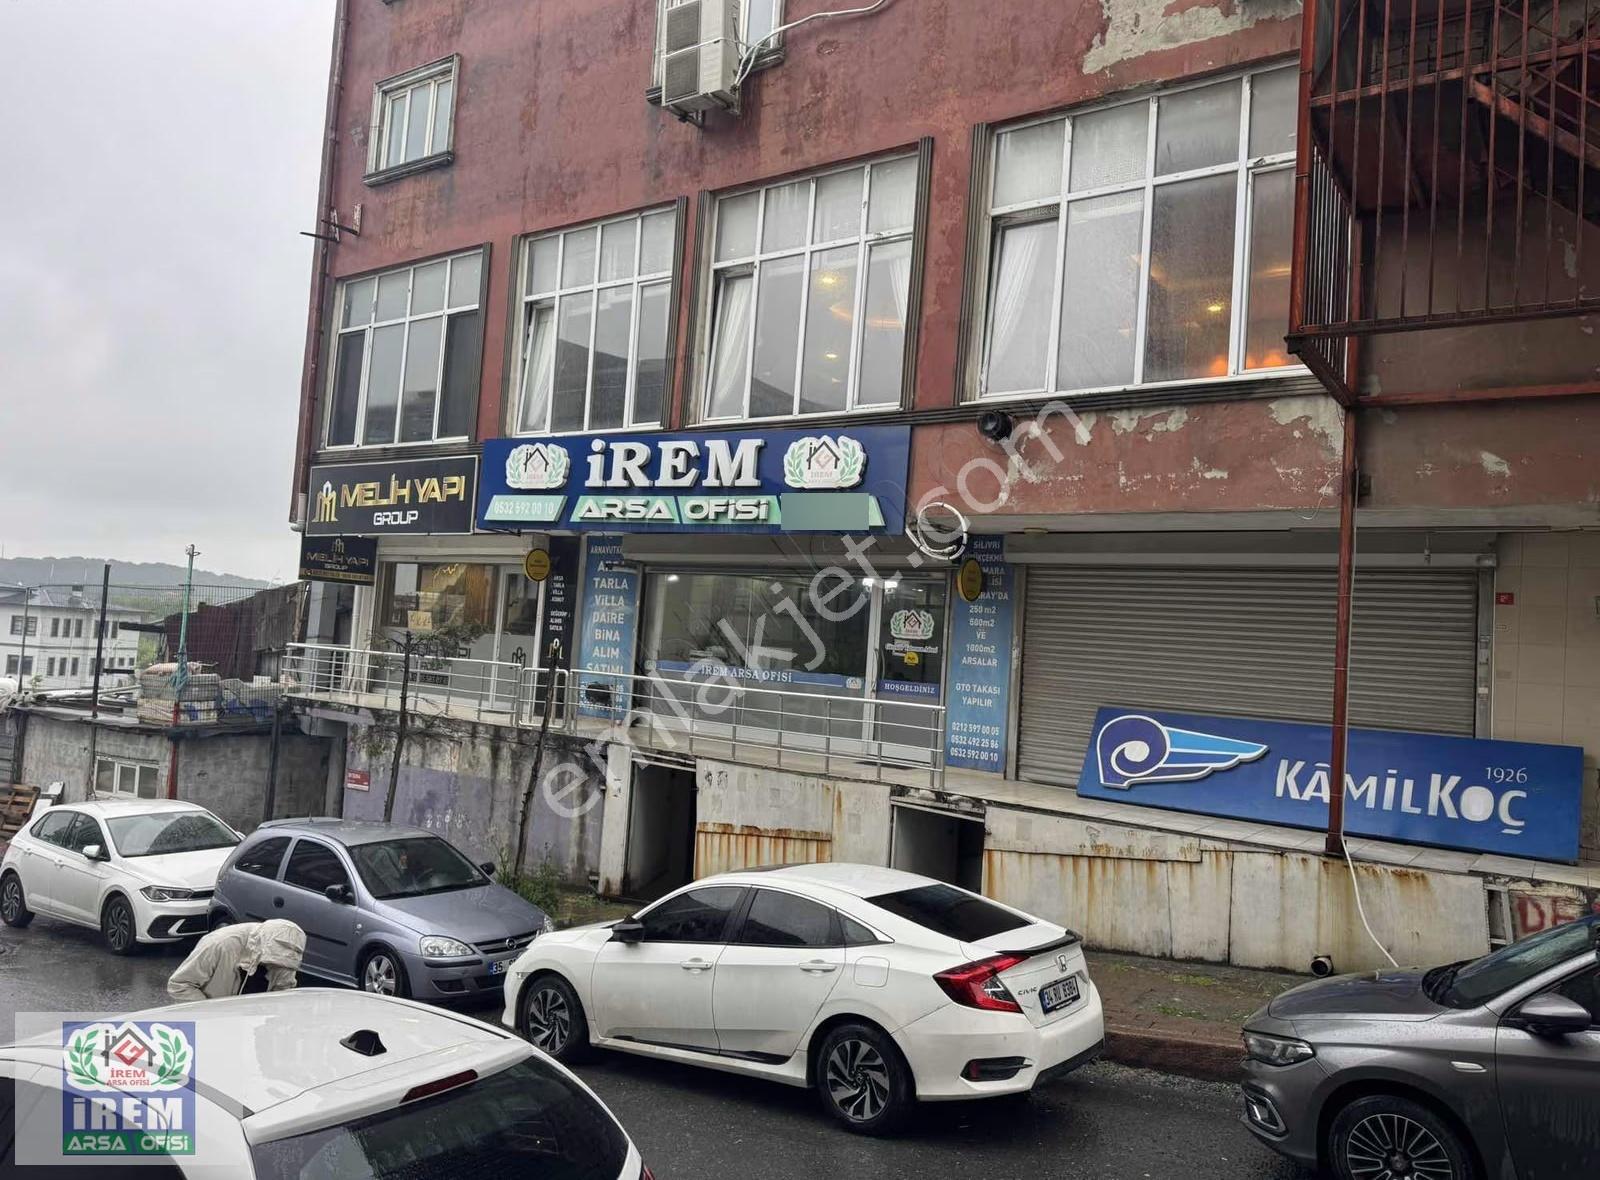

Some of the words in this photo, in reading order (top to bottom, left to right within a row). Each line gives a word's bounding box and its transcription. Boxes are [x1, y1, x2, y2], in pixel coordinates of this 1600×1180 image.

[414, 475, 466, 503] YAPI
[579, 498, 675, 519] ARSA
[373, 510, 419, 526] GROUP
[593, 577, 628, 590] TARLA
[592, 611, 625, 624] DAİRE
[594, 629, 620, 641] BİNA
[976, 631, 986, 640] VE
[593, 646, 619, 659] ALIM
[961, 656, 998, 667] ARSALAR
[586, 662, 624, 675] SATIMI
[731, 667, 758, 680] ARSA
[955, 682, 971, 692] OTO
[973, 684, 1000, 696] TAKASI
[962, 696, 993, 707] YAPILIR
[952, 722, 968, 732] 0212
[968, 724, 980, 733] 597
[982, 725, 990, 734] 00
[991, 727, 1000, 736] 05
[951, 735, 967, 745] 0532
[968, 737, 980, 746] 492
[981, 738, 989, 747] 25
[990, 740, 999, 749] 86
[950, 748, 966, 758] 0532
[967, 750, 979, 759] 592
[980, 752, 989, 760] 00
[990, 752, 999, 762] 10
[1486, 767, 1528, 784] 1926
[493, 961, 503, 974] 35
